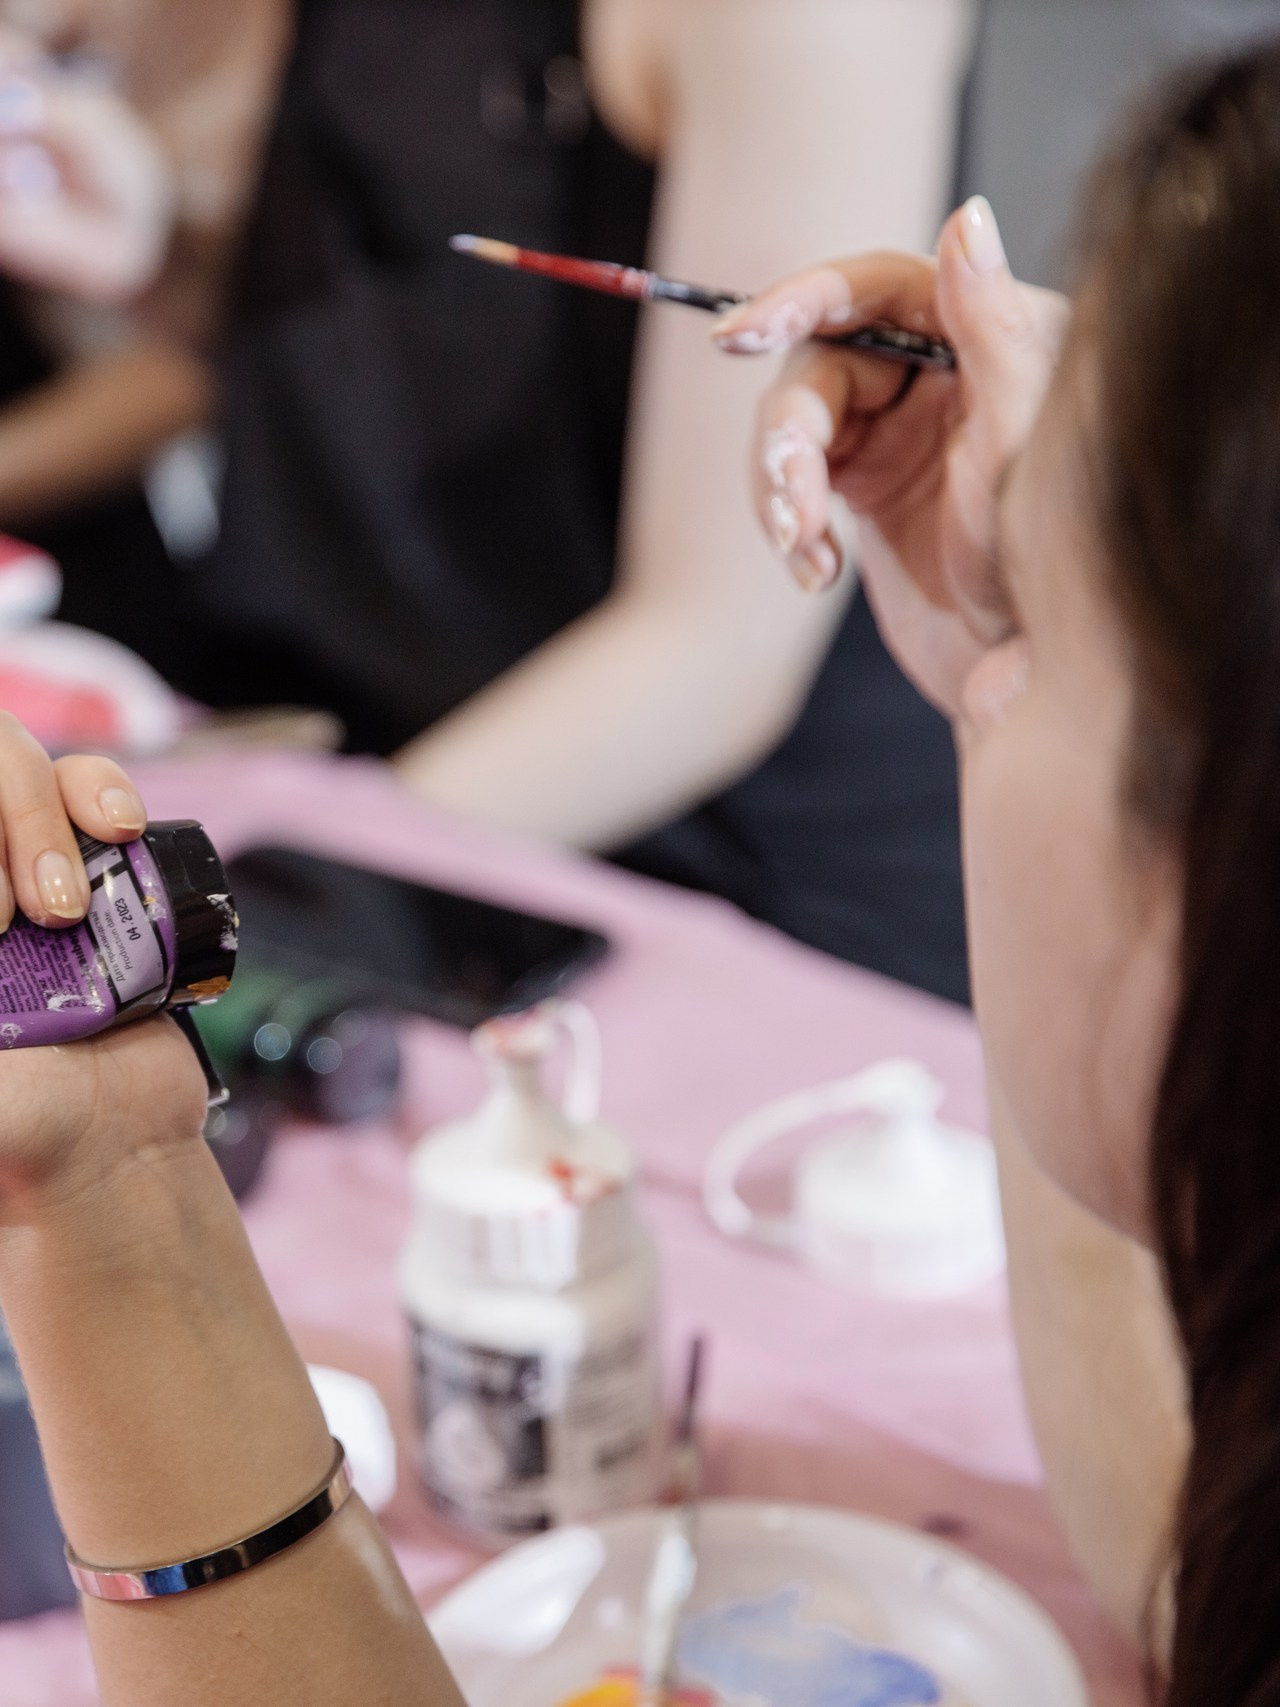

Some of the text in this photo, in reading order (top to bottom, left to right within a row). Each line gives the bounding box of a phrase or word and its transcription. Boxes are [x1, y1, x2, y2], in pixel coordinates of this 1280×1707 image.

[90, 910, 126, 983] Дата производства/
[104, 909, 134, 970] Production date:
[114, 897, 142, 941] 04.2023
